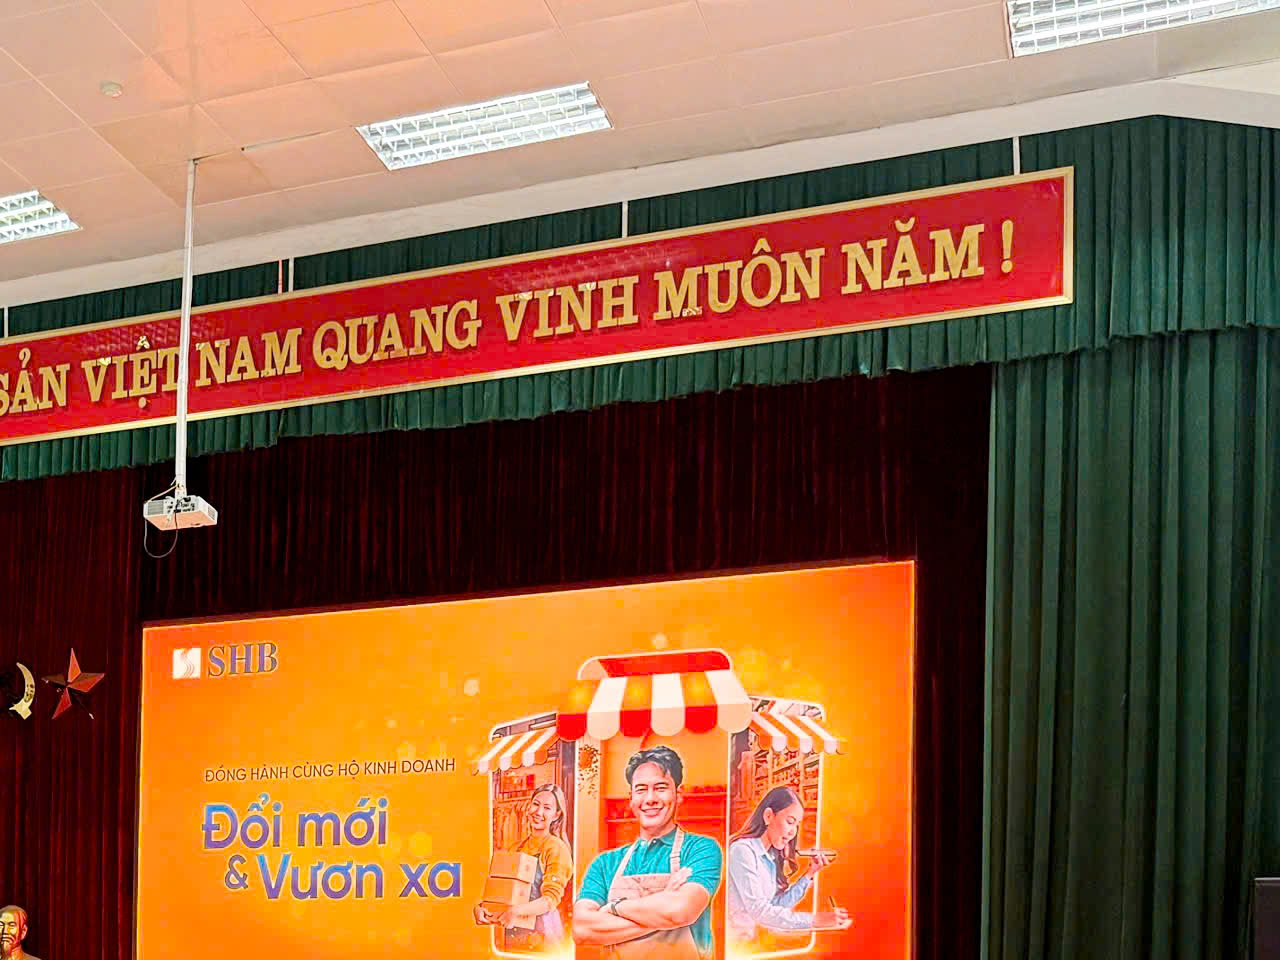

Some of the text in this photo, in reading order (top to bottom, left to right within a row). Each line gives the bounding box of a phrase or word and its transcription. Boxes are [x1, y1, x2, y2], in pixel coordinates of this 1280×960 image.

[81, 335, 180, 409] VIỆT
[195, 327, 302, 388] NAM
[311, 298, 482, 371] QUANG
[496, 274, 638, 342] VINH
[653, 238, 826, 321] MUÔN
[842, 220, 984, 294] NĂM
[208, 642, 277, 677] SHB
[205, 758, 455, 782] ĐỒNG HÀNH CÙNG HỘ KINH DOANH
[201, 793, 388, 849] Đổi mới
[224, 854, 462, 900] & Vươn xa
